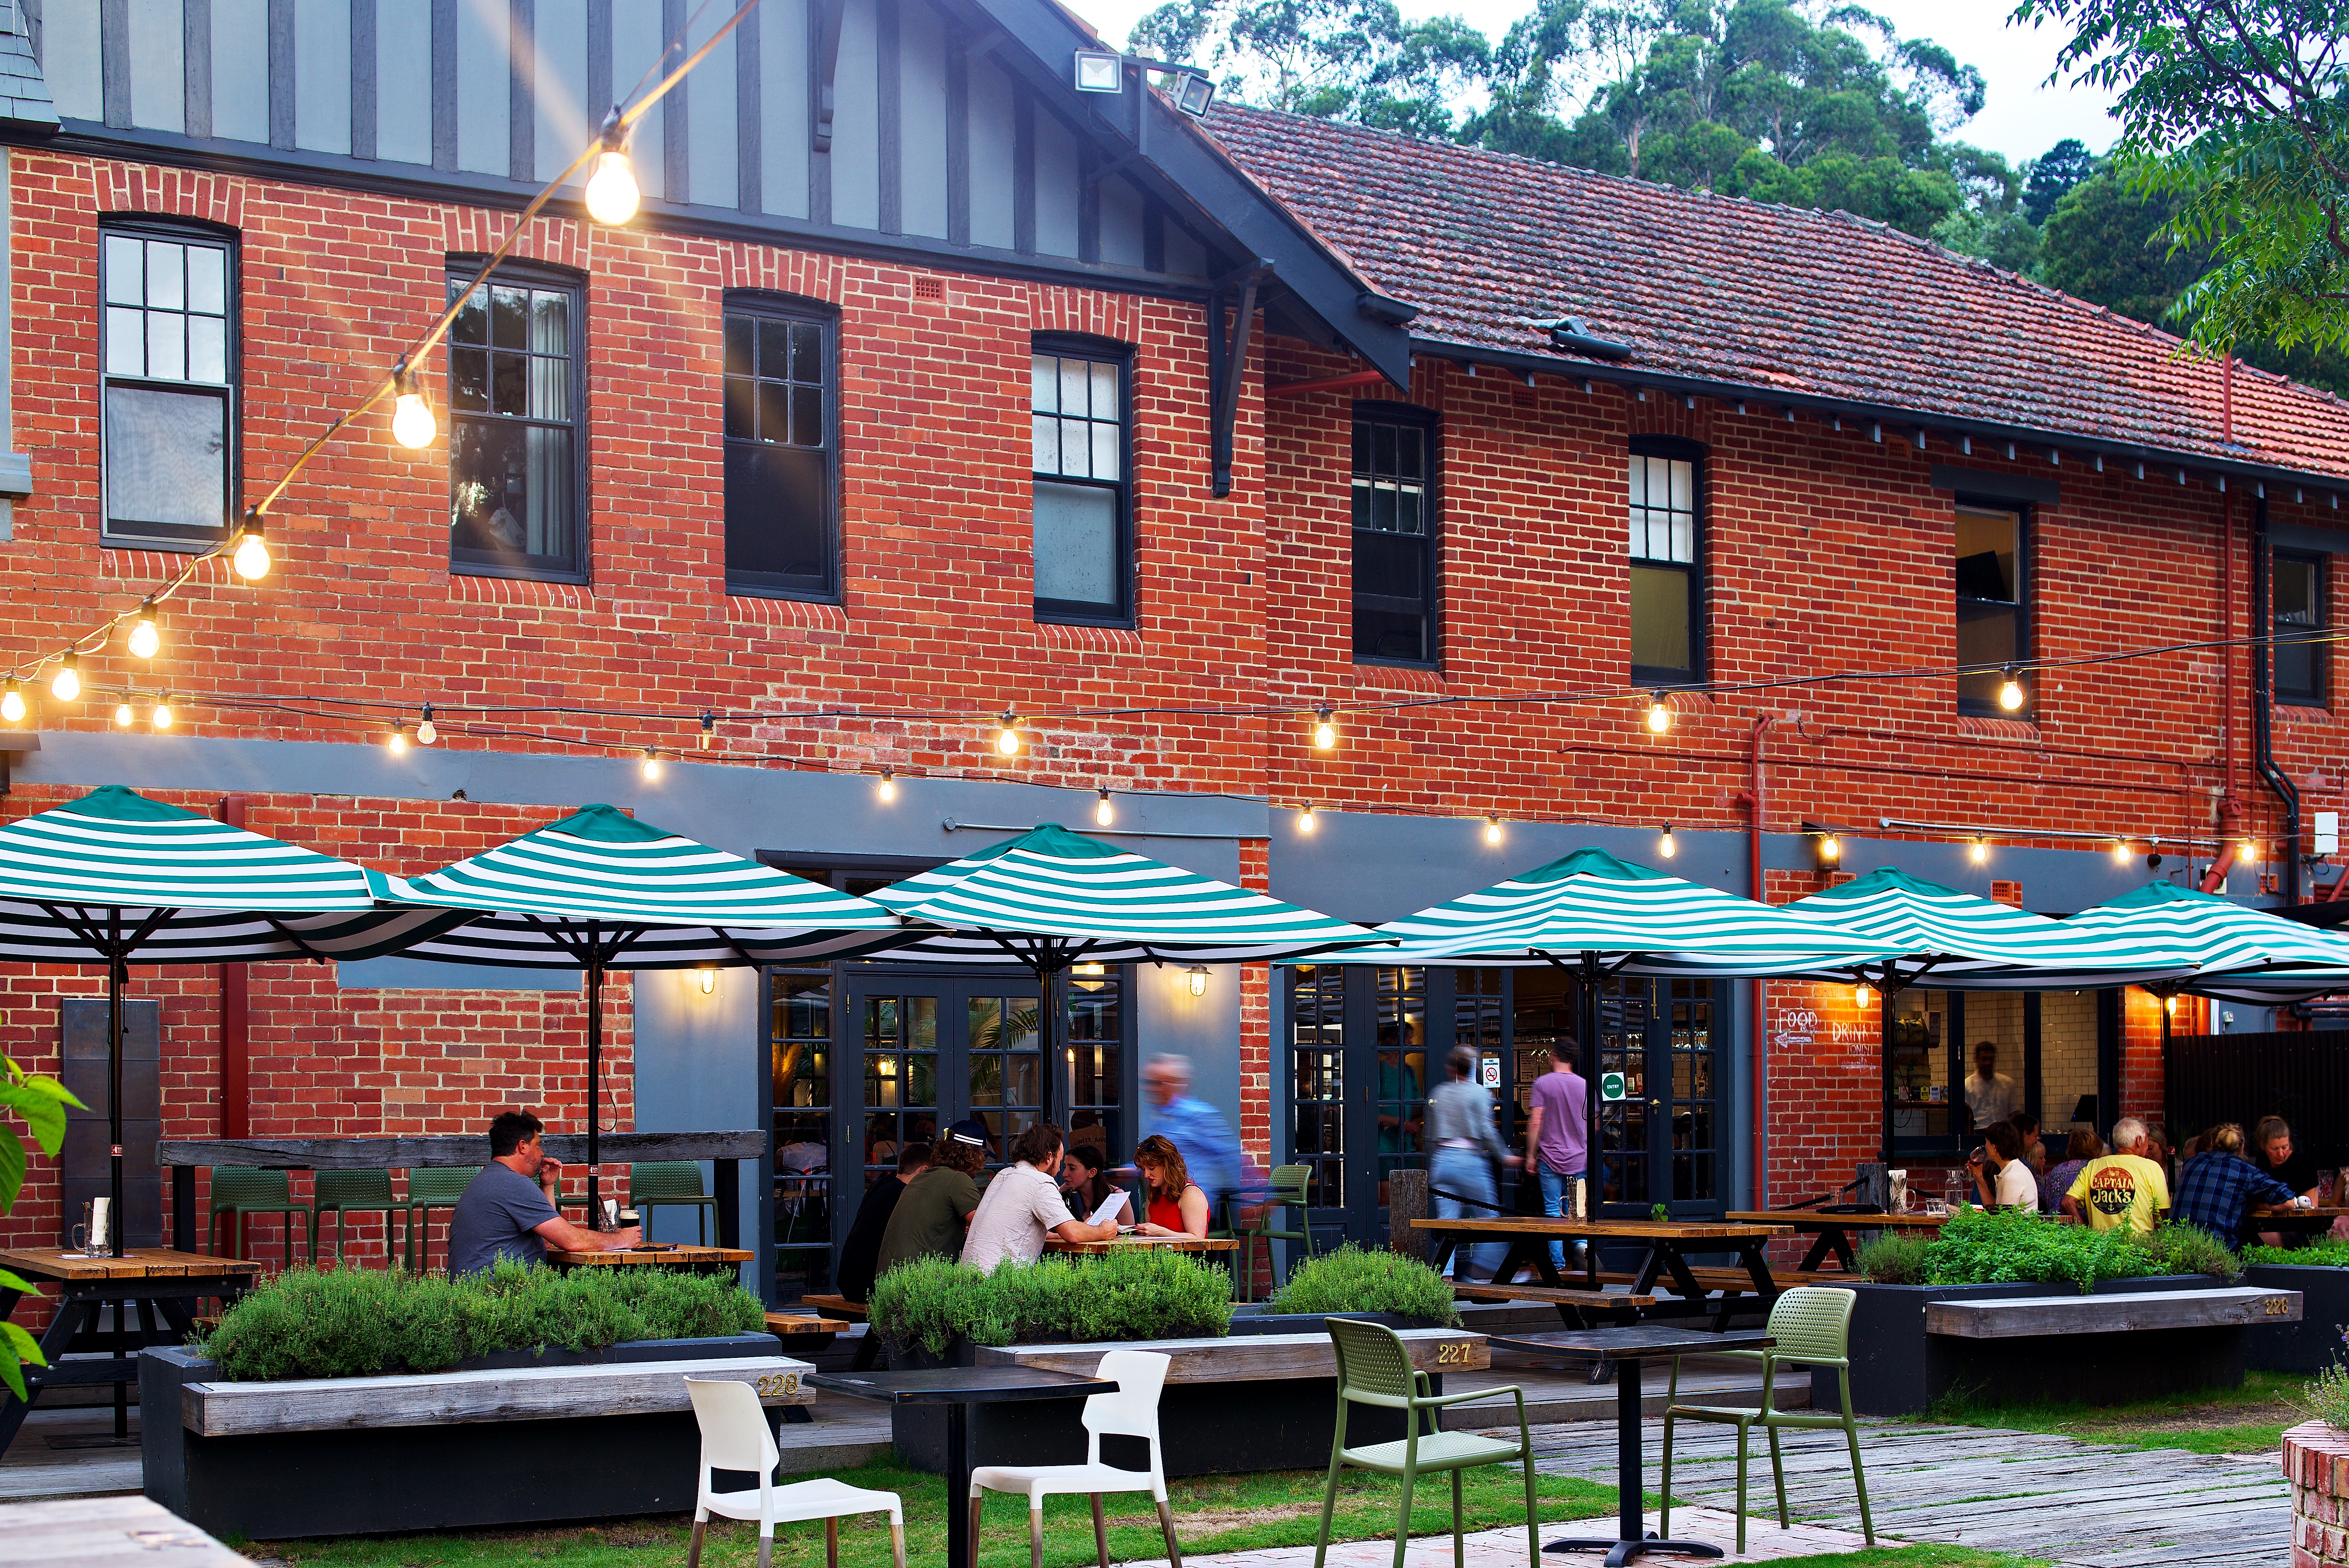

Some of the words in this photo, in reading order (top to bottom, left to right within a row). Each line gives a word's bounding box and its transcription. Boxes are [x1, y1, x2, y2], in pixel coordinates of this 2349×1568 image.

[1779, 1009, 1818, 1033] FOOD
[1832, 1021, 1869, 1042] DRINK
[1850, 1044, 1870, 1055] ONLY
[1074, 1137, 1092, 1145] UNITE
[2090, 1177, 2136, 1189] CAPTAIN
[2092, 1188, 2132, 1203] Jack's
[2265, 1297, 2288, 1315] 226
[1438, 1343, 1471, 1363] 227
[758, 1373, 798, 1397] 228
